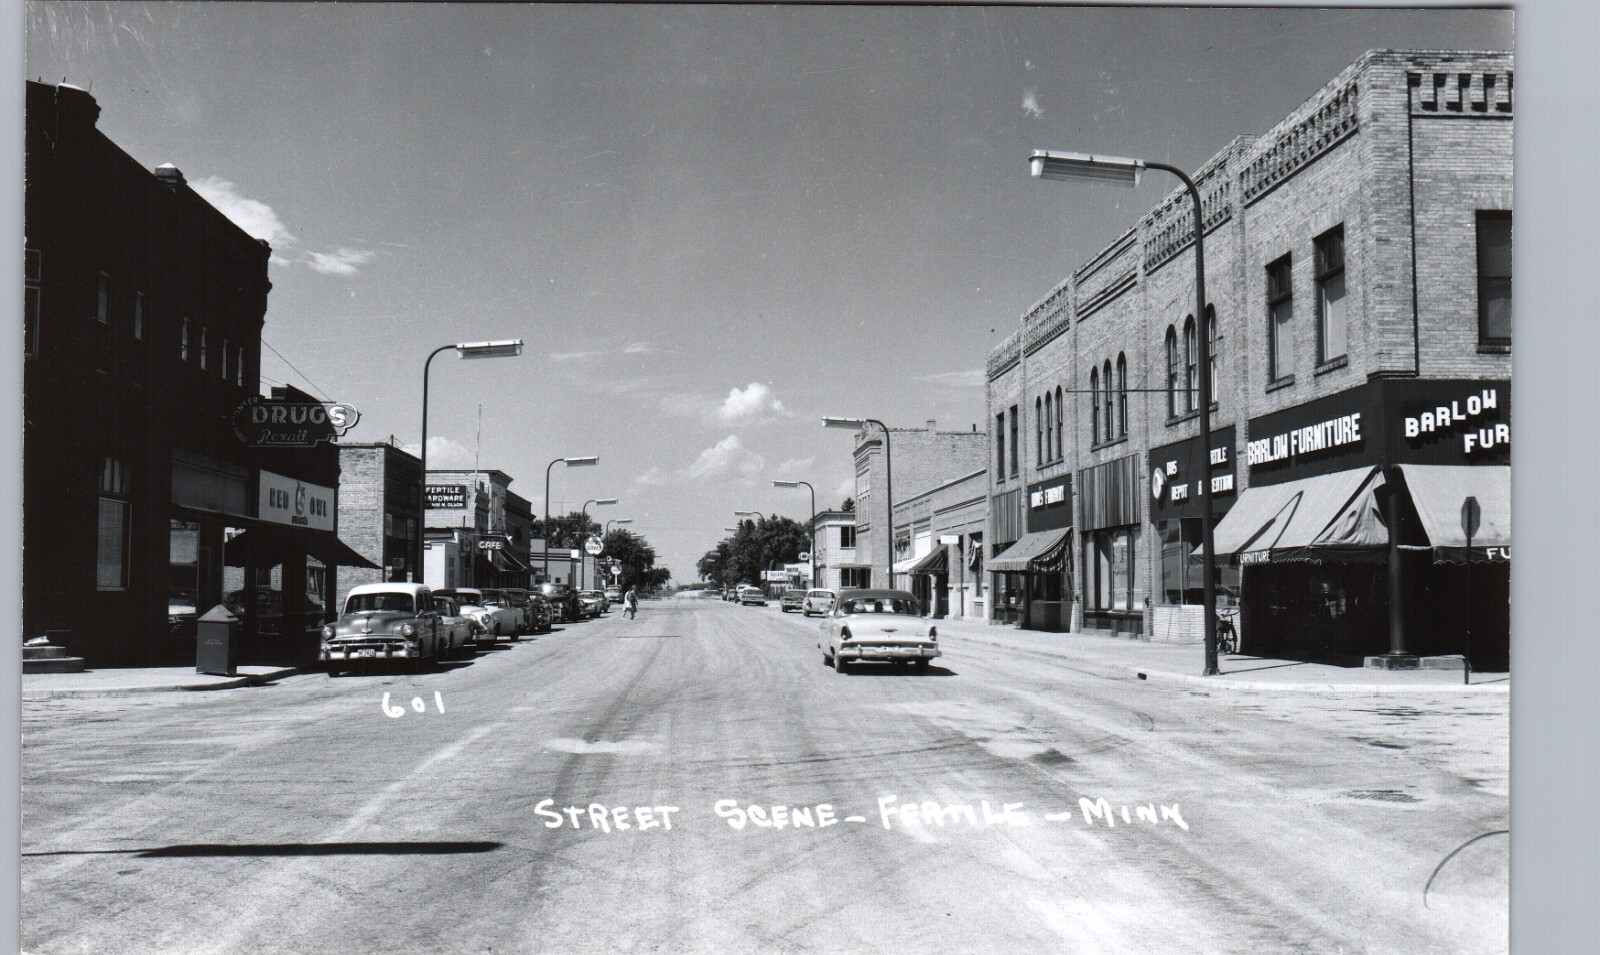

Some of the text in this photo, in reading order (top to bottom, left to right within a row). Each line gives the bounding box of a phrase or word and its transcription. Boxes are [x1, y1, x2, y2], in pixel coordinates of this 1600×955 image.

[252, 406, 346, 427] DRUGS
[1405, 389, 1496, 437] BARLOW
[257, 429, 308, 445] Rexall
[1247, 412, 1361, 466] BARLOW FURNITURE
[1464, 424, 1509, 453] FUR
[425, 486, 460, 494] FERTILE
[1171, 484, 1188, 501] DEPOT
[310, 496, 327, 517] OWL
[479, 541, 501, 549] CAFE
[1236, 549, 1270, 564] FURNITURE
